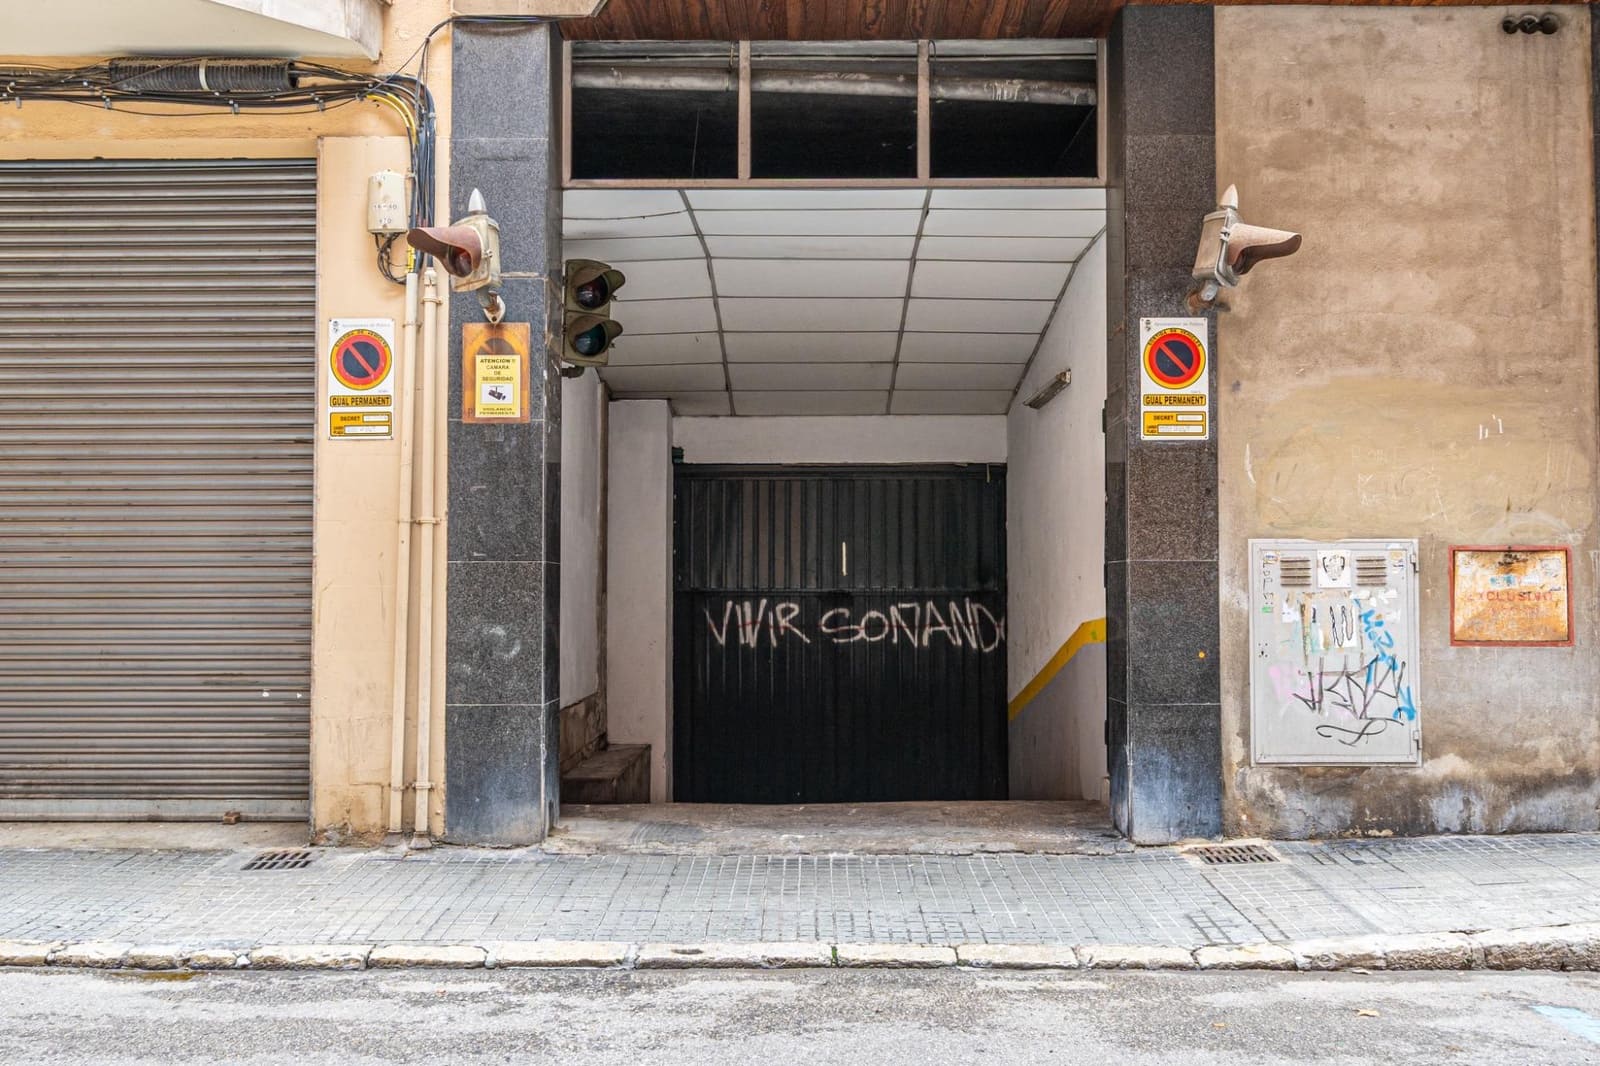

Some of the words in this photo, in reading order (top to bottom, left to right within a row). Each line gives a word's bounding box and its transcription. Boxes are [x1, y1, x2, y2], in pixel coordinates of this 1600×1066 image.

[333, 397, 350, 406] GUAL
[351, 397, 389, 406] PERMANENT
[1146, 396, 1163, 405] GUAL
[1165, 396, 1203, 405] PERMANENT
[704, 599, 811, 648] VIVIR
